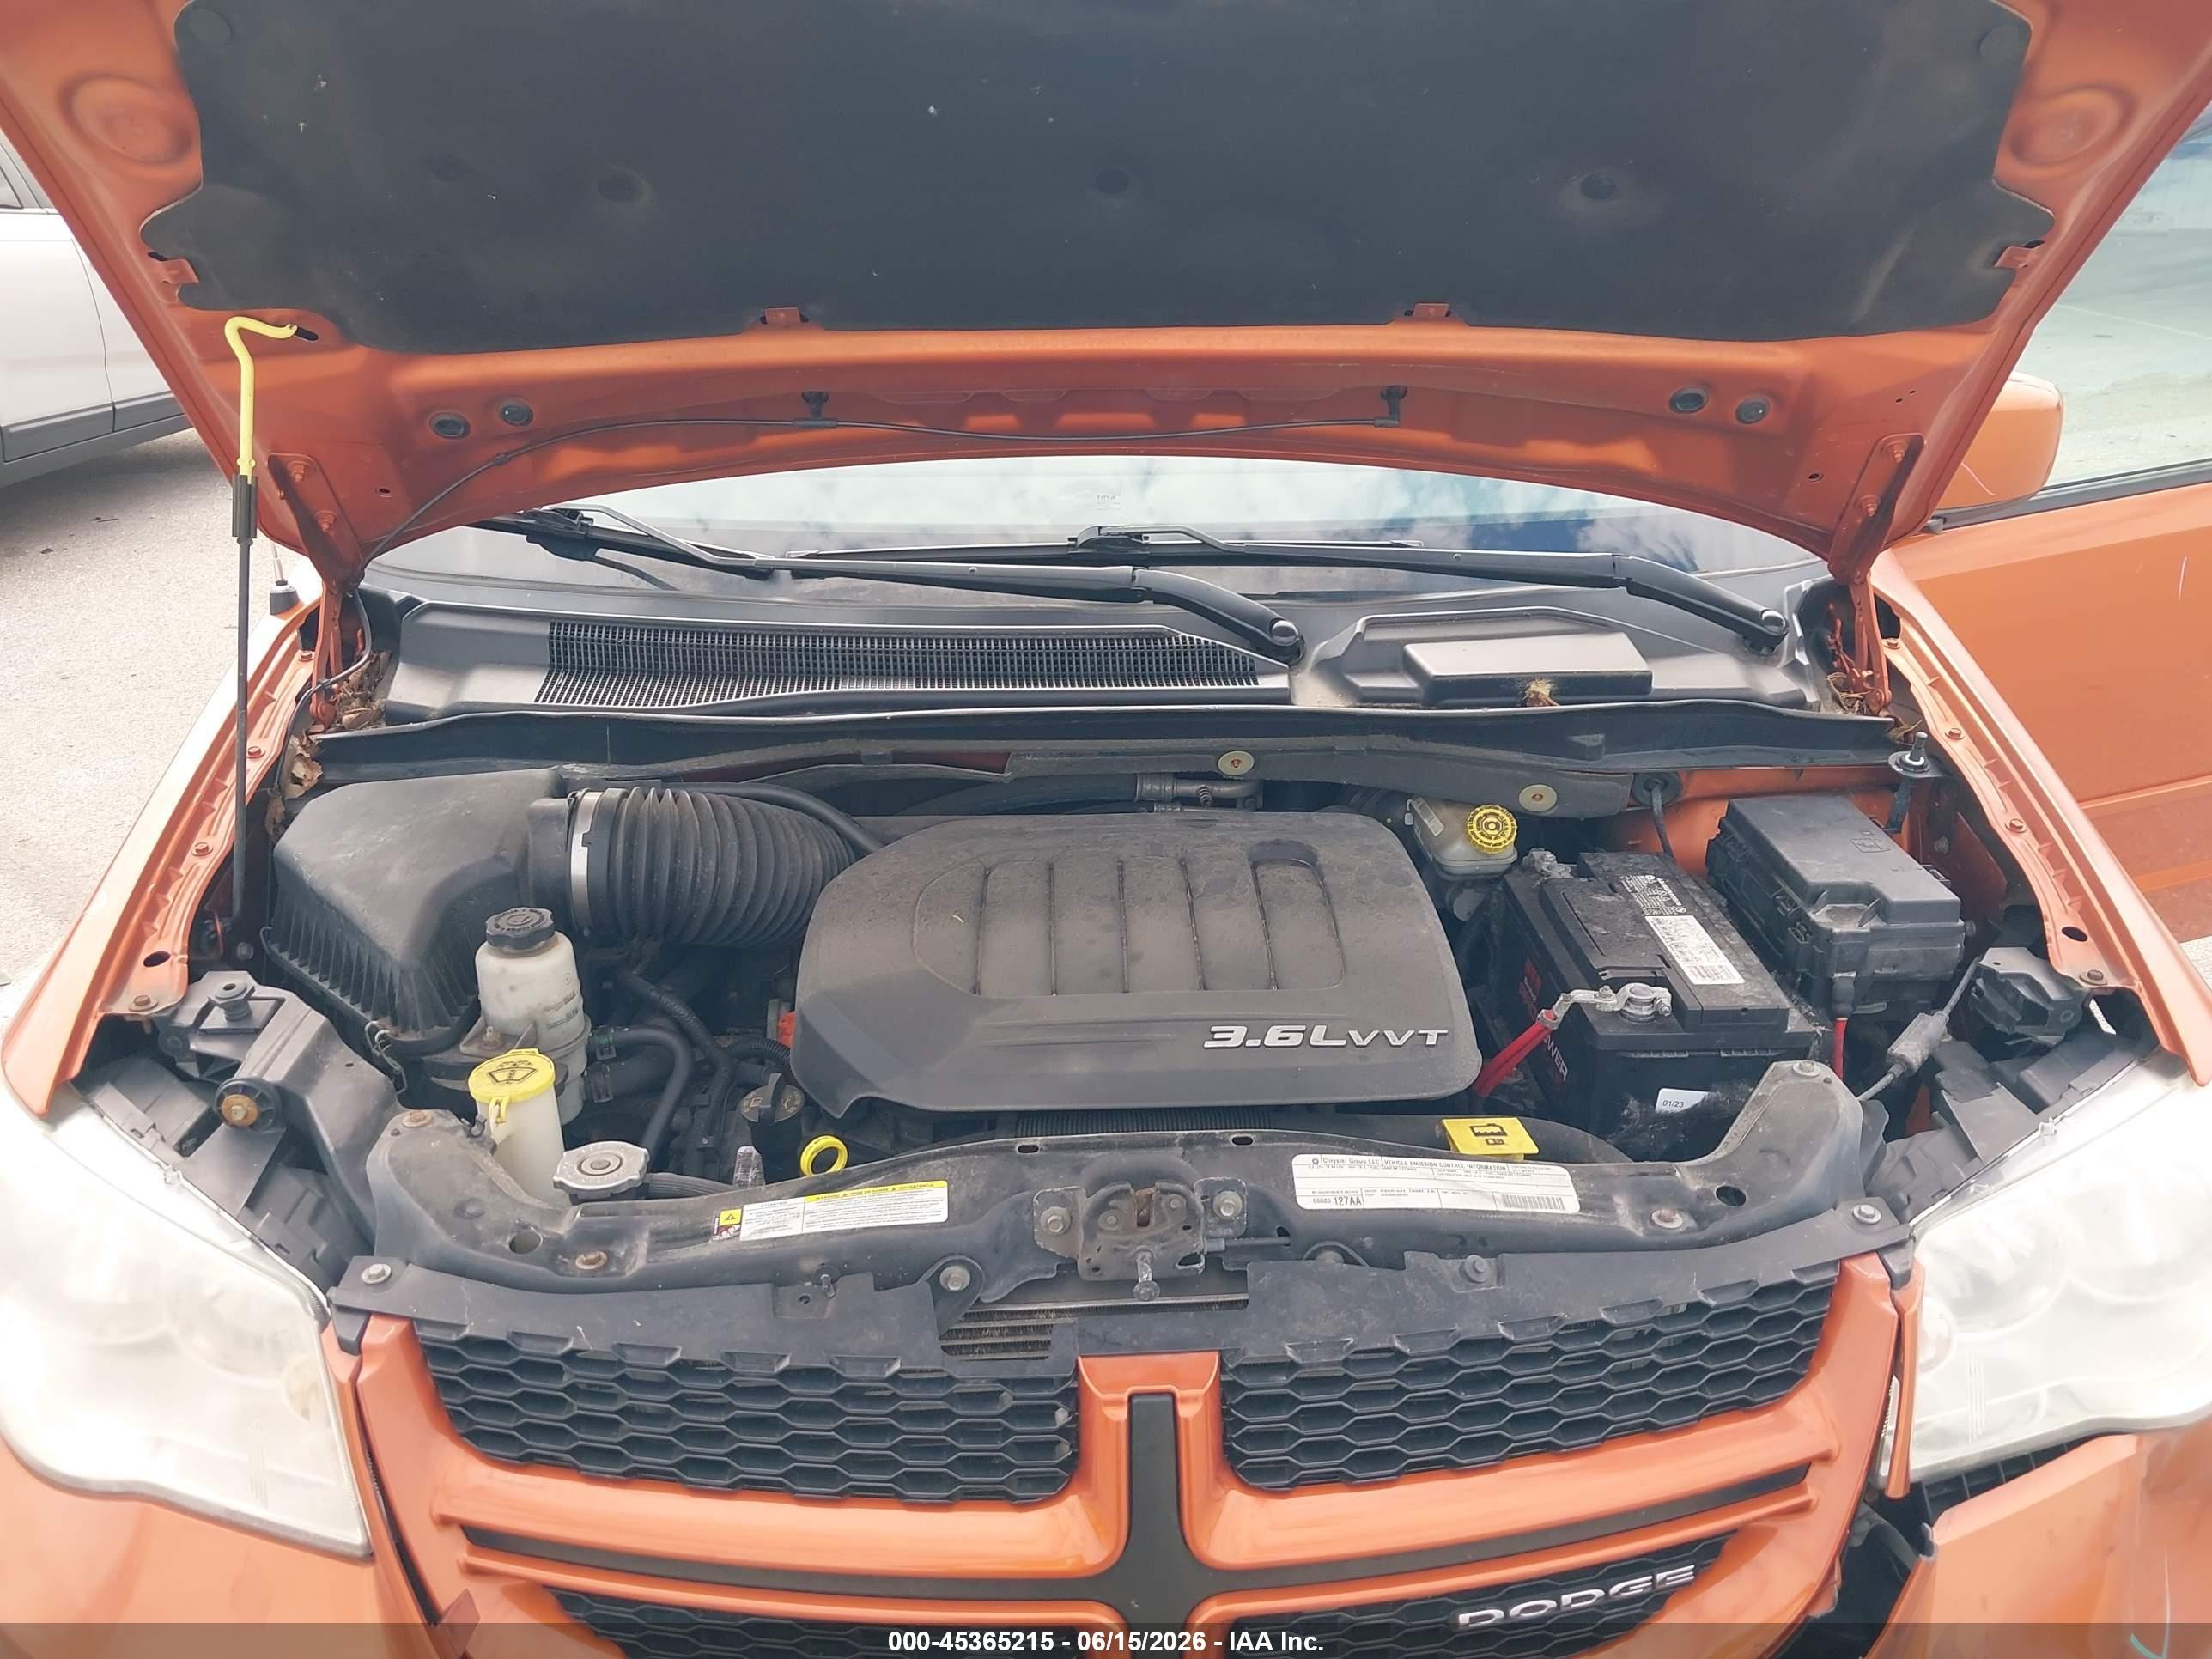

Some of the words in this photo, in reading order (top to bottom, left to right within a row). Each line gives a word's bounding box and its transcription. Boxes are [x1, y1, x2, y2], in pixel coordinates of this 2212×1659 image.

[1203, 1024, 1347, 1048] 3.6L
[1347, 1030, 1449, 1048] VVT
[1662, 1099, 1685, 1108] 01/23
[1322, 1157, 1347, 1165] Chrysler
[1466, 1163, 1507, 1171] INFORMATION
[1334, 1195, 1363, 1206] 127AA
[1458, 1565, 1696, 1627] DODGE
